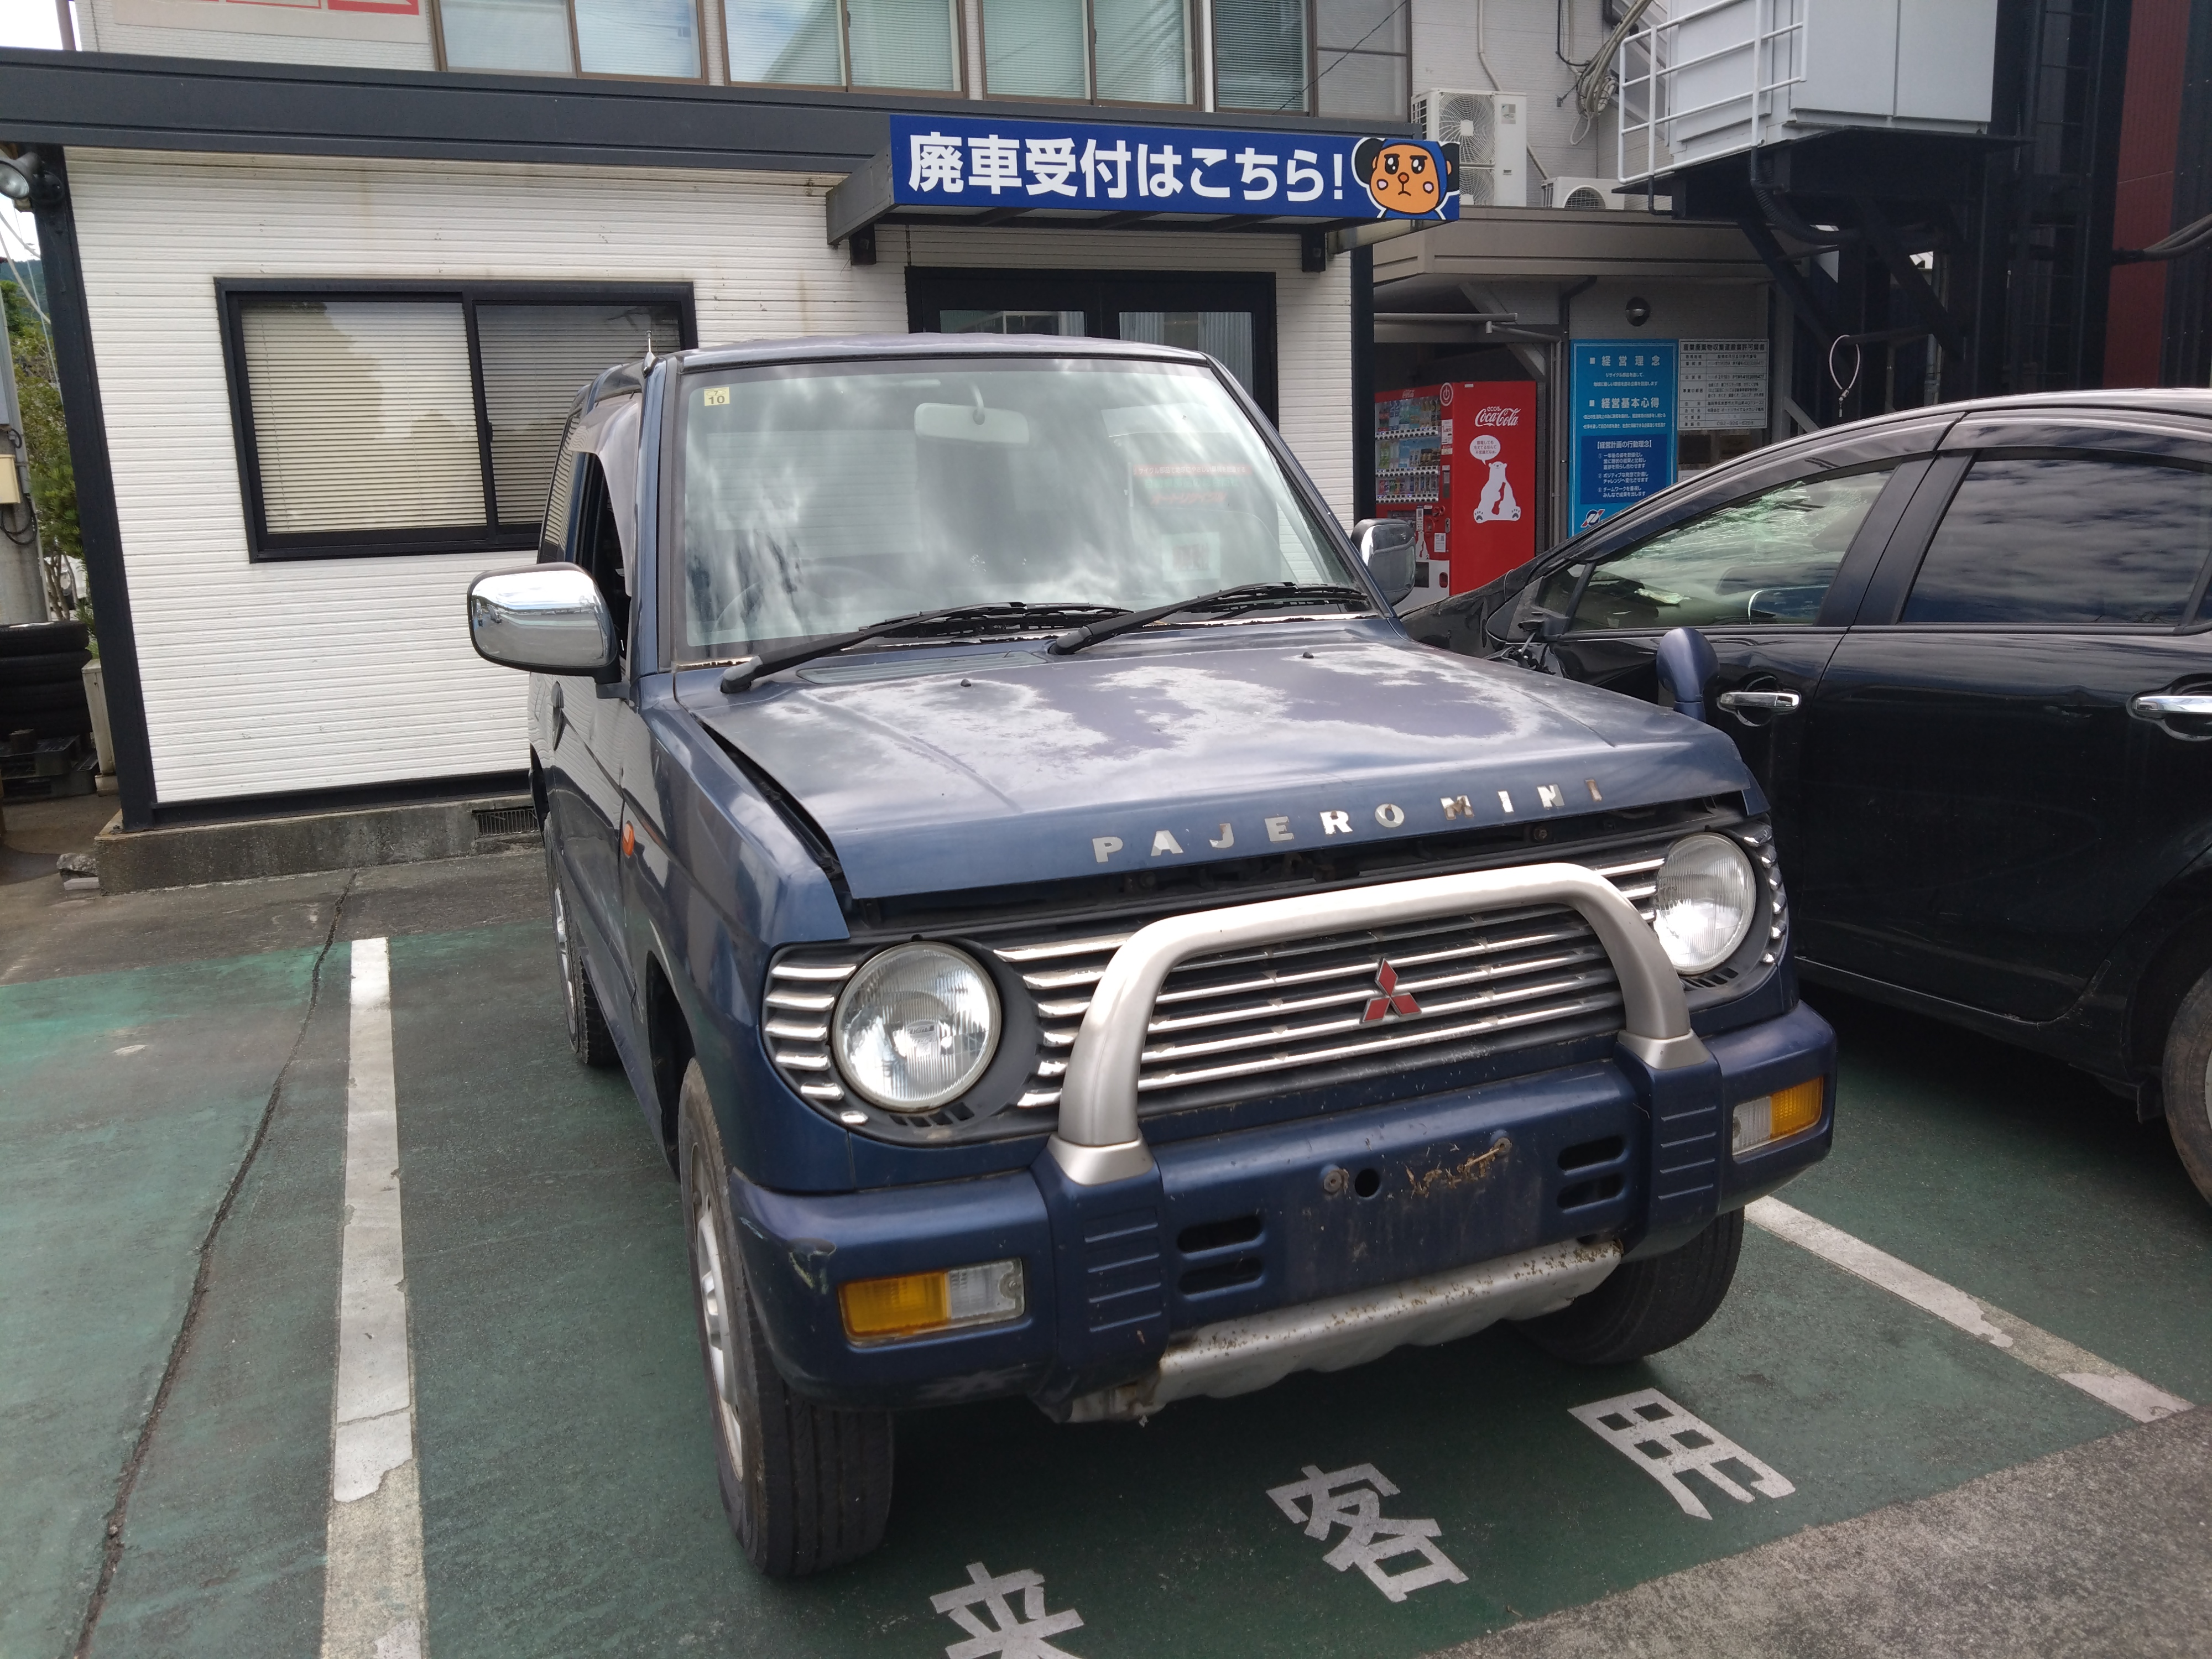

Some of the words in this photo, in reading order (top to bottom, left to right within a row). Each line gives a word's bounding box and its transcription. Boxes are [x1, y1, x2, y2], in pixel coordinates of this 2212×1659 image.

[909, 132, 1343, 201] 廃車受付はこちら!
[1601, 355, 1660, 366] 経営理念
[708, 395, 725, 405] 10
[1601, 397, 1660, 409] 経営基本心得
[1474, 408, 1521, 427] Coca-Cola
[1092, 803, 1405, 863] PAJERO
[1440, 779, 1603, 820] MINI
